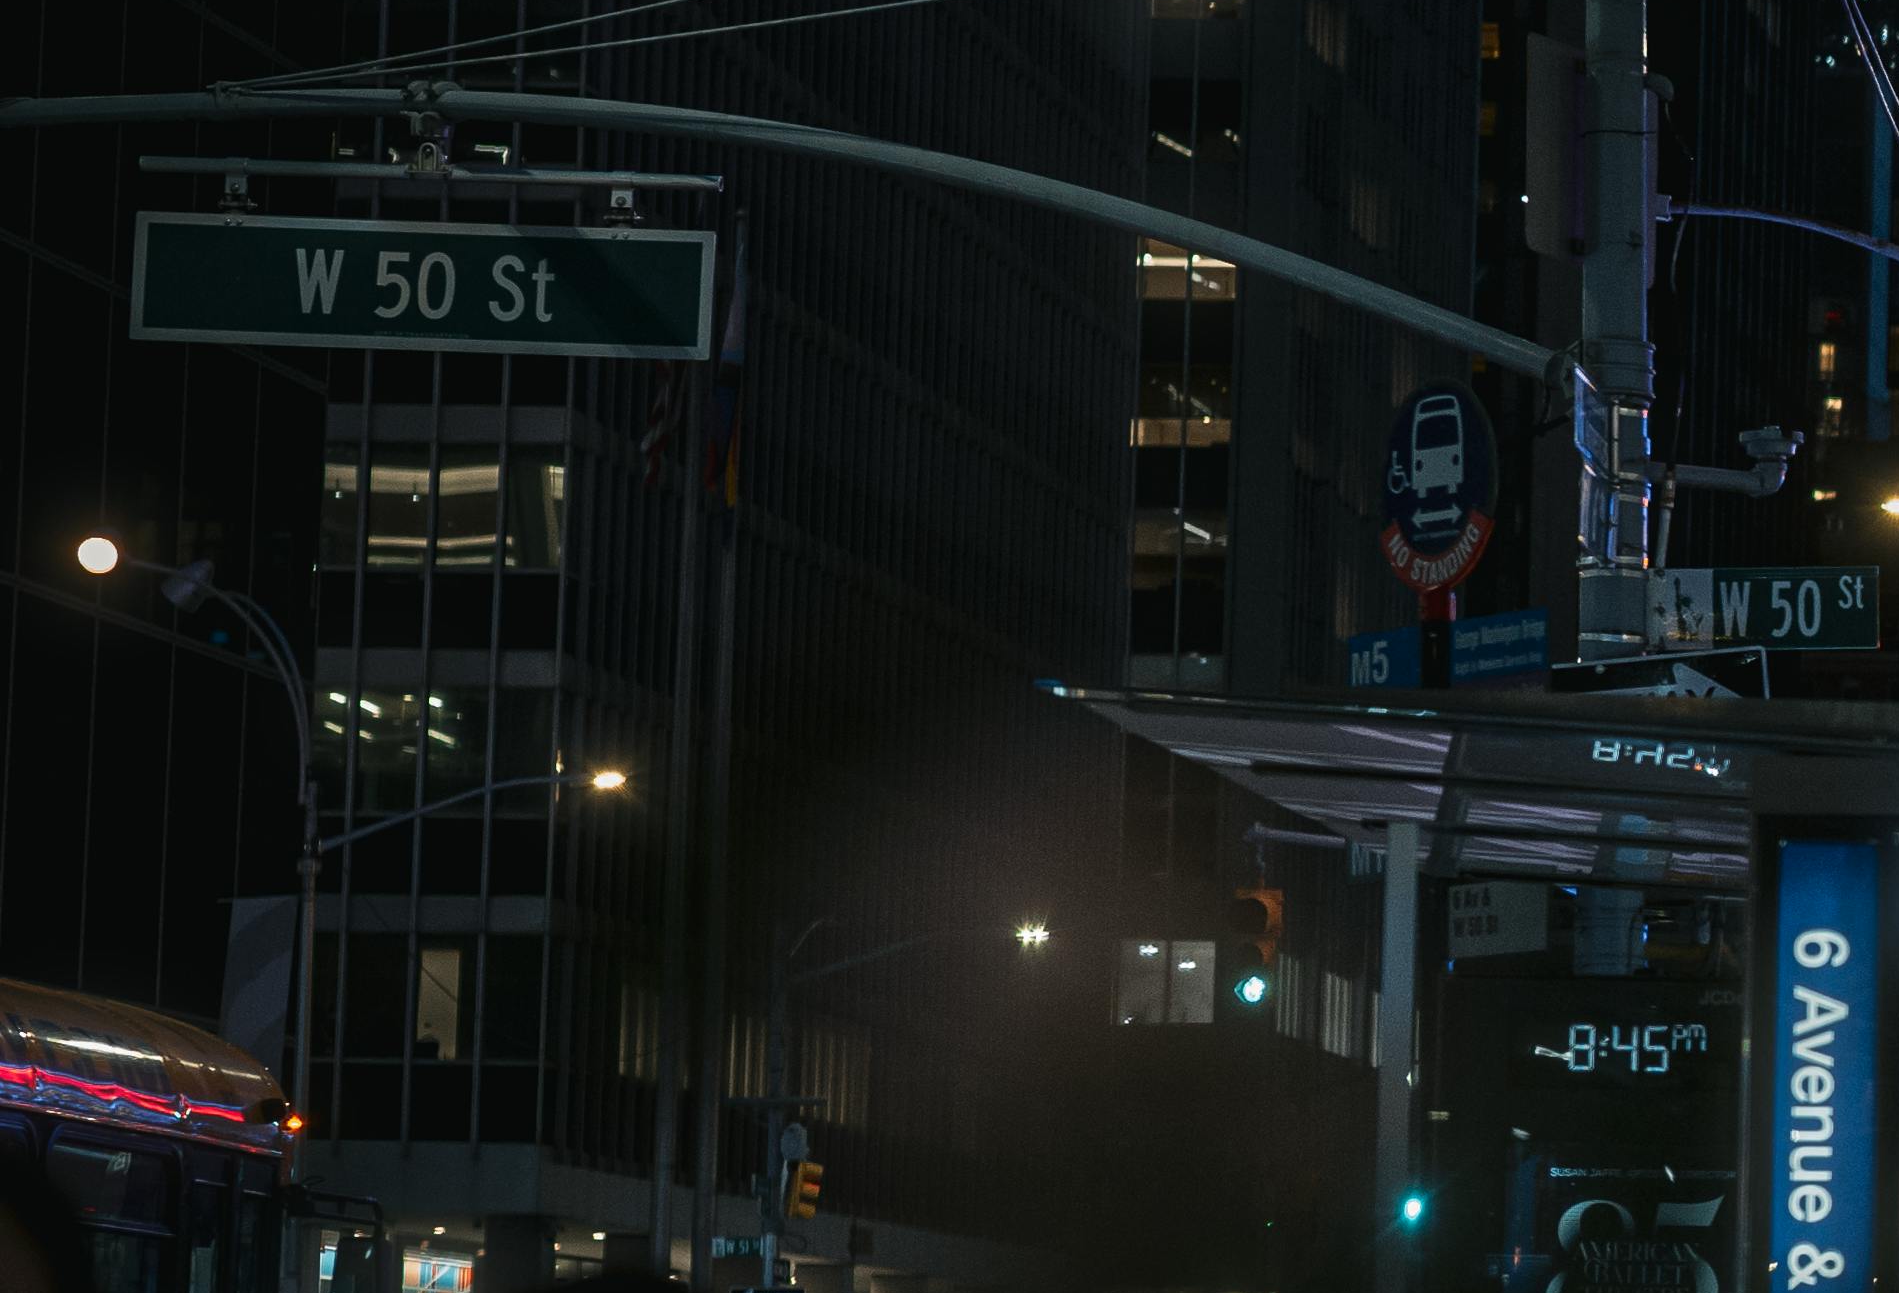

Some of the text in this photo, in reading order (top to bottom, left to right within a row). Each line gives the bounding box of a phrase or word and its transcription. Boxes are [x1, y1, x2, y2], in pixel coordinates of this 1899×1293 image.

[296, 248, 556, 323] W 50 St
[1388, 522, 1480, 584] NO STANDING
[1719, 574, 1865, 638] W 50 St
[1351, 639, 1390, 687] M5
[1792, 928, 1851, 969] 6
[1787, 984, 1849, 1224] Avenue
[1787, 1243, 1845, 1291] &
